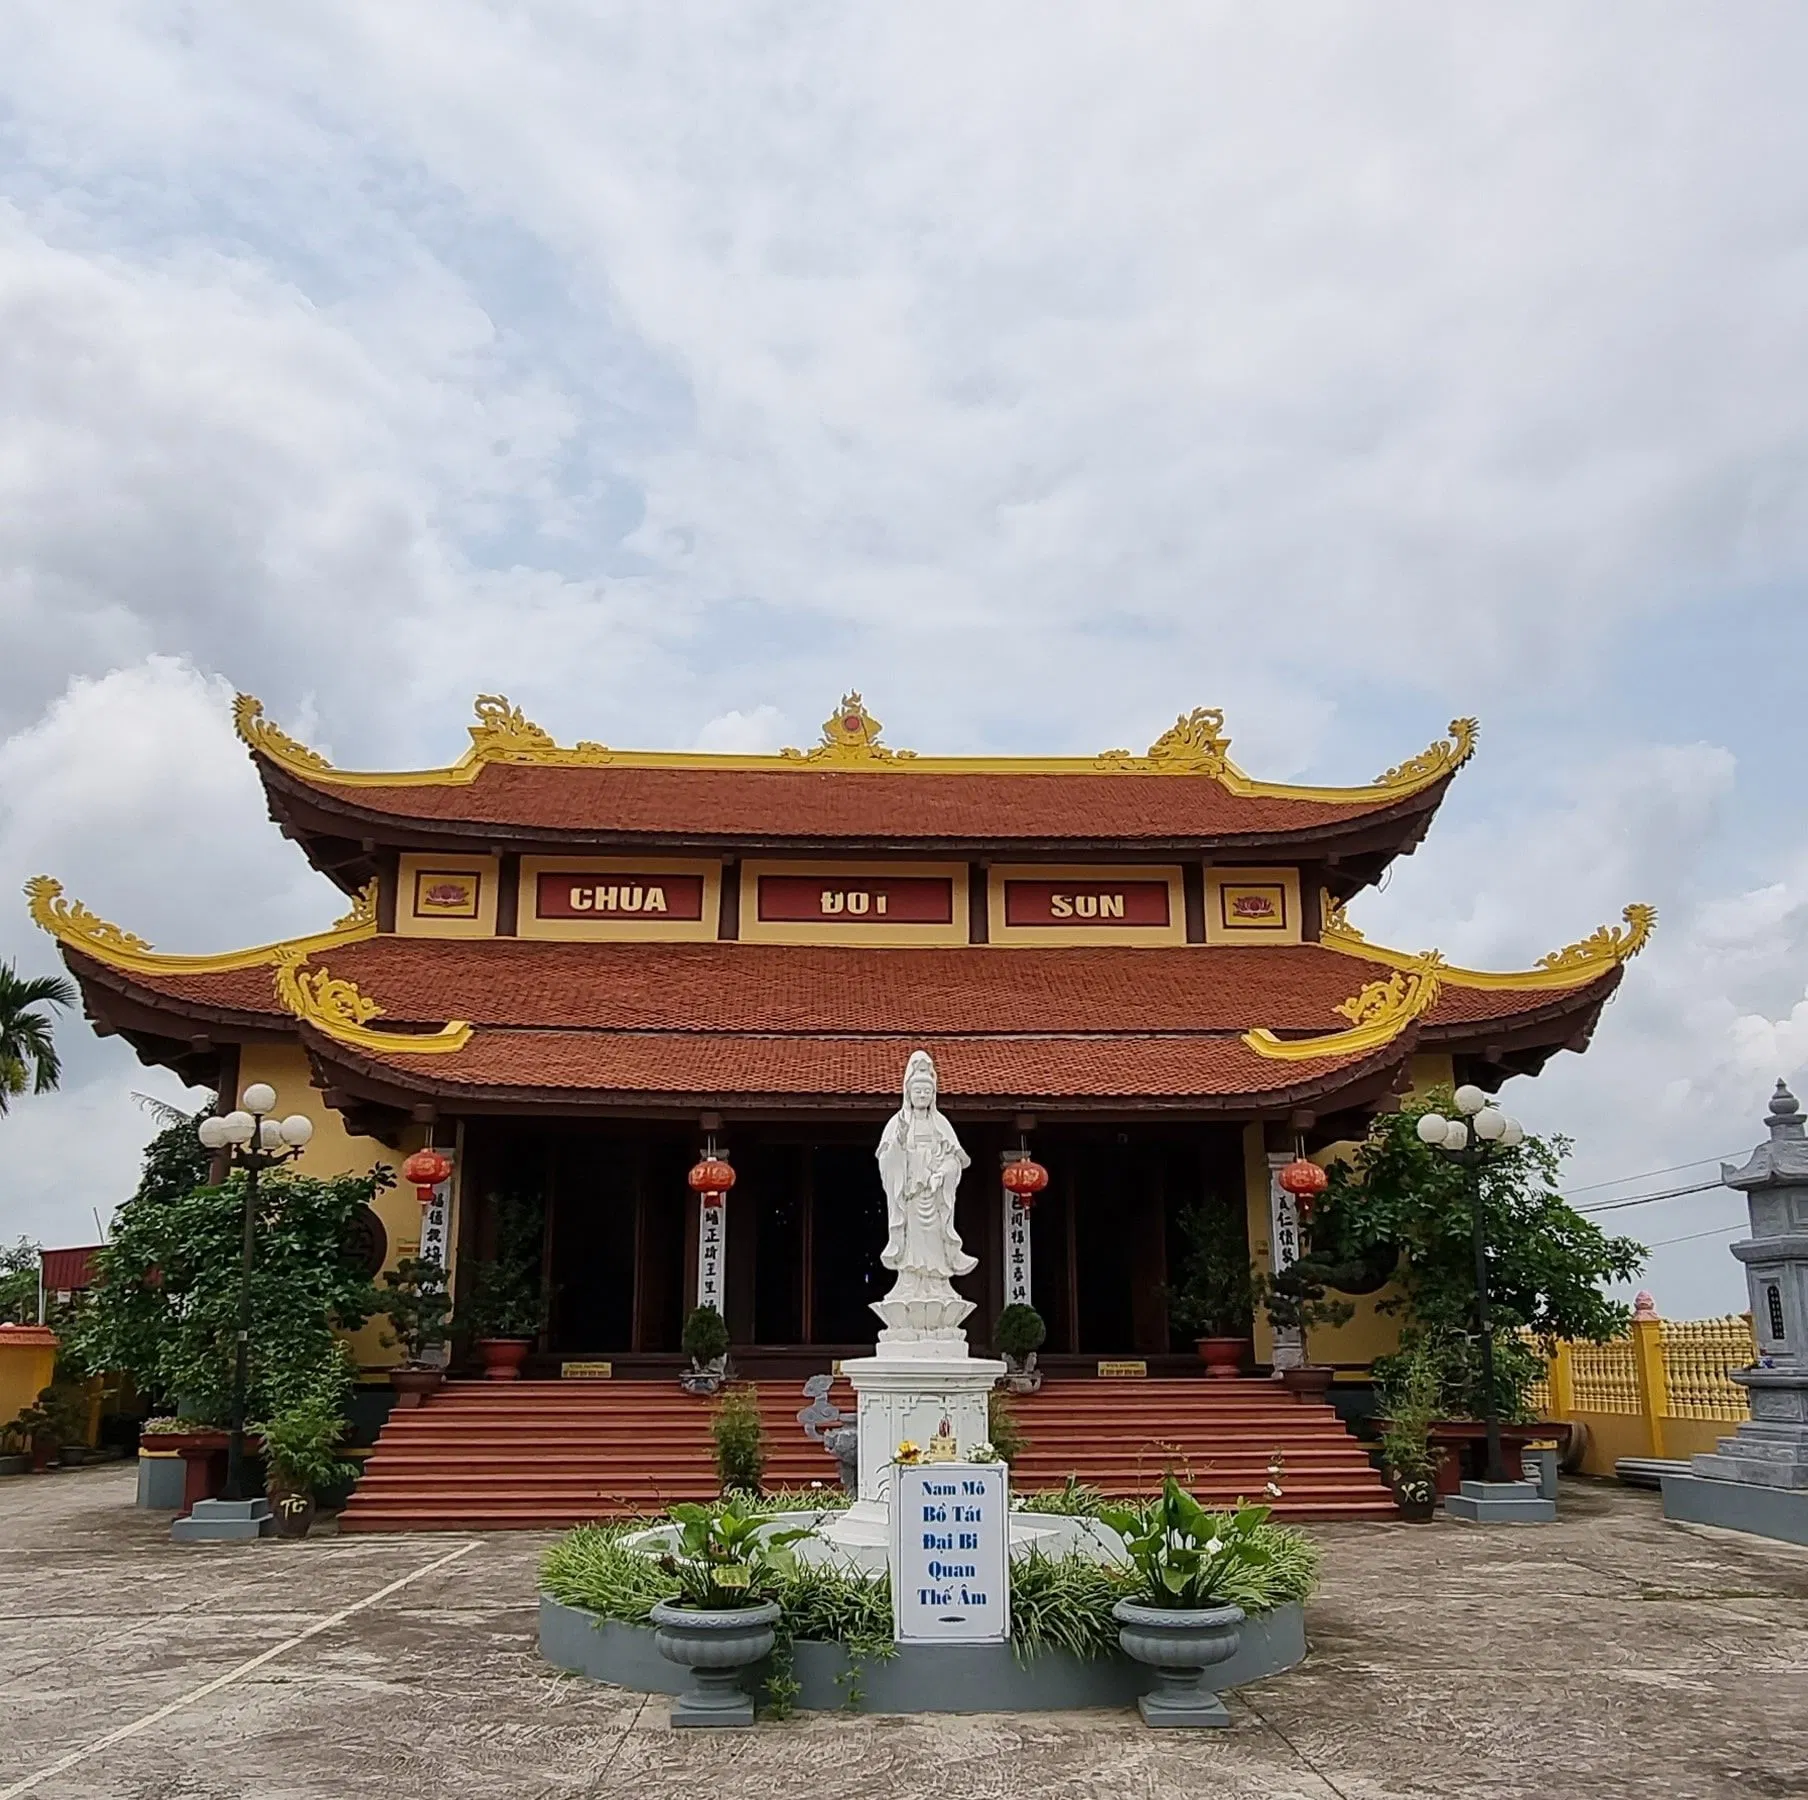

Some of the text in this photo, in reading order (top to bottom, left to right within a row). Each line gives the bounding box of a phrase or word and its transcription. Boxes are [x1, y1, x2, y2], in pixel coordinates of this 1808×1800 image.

[921, 1480, 985, 1496] Nam Mô
[922, 1502, 982, 1523] Bồ Tát
[922, 1533, 978, 1554] Đại Bi
[928, 1560, 976, 1581] Quan
[917, 1583, 987, 1606] Thế Âm
